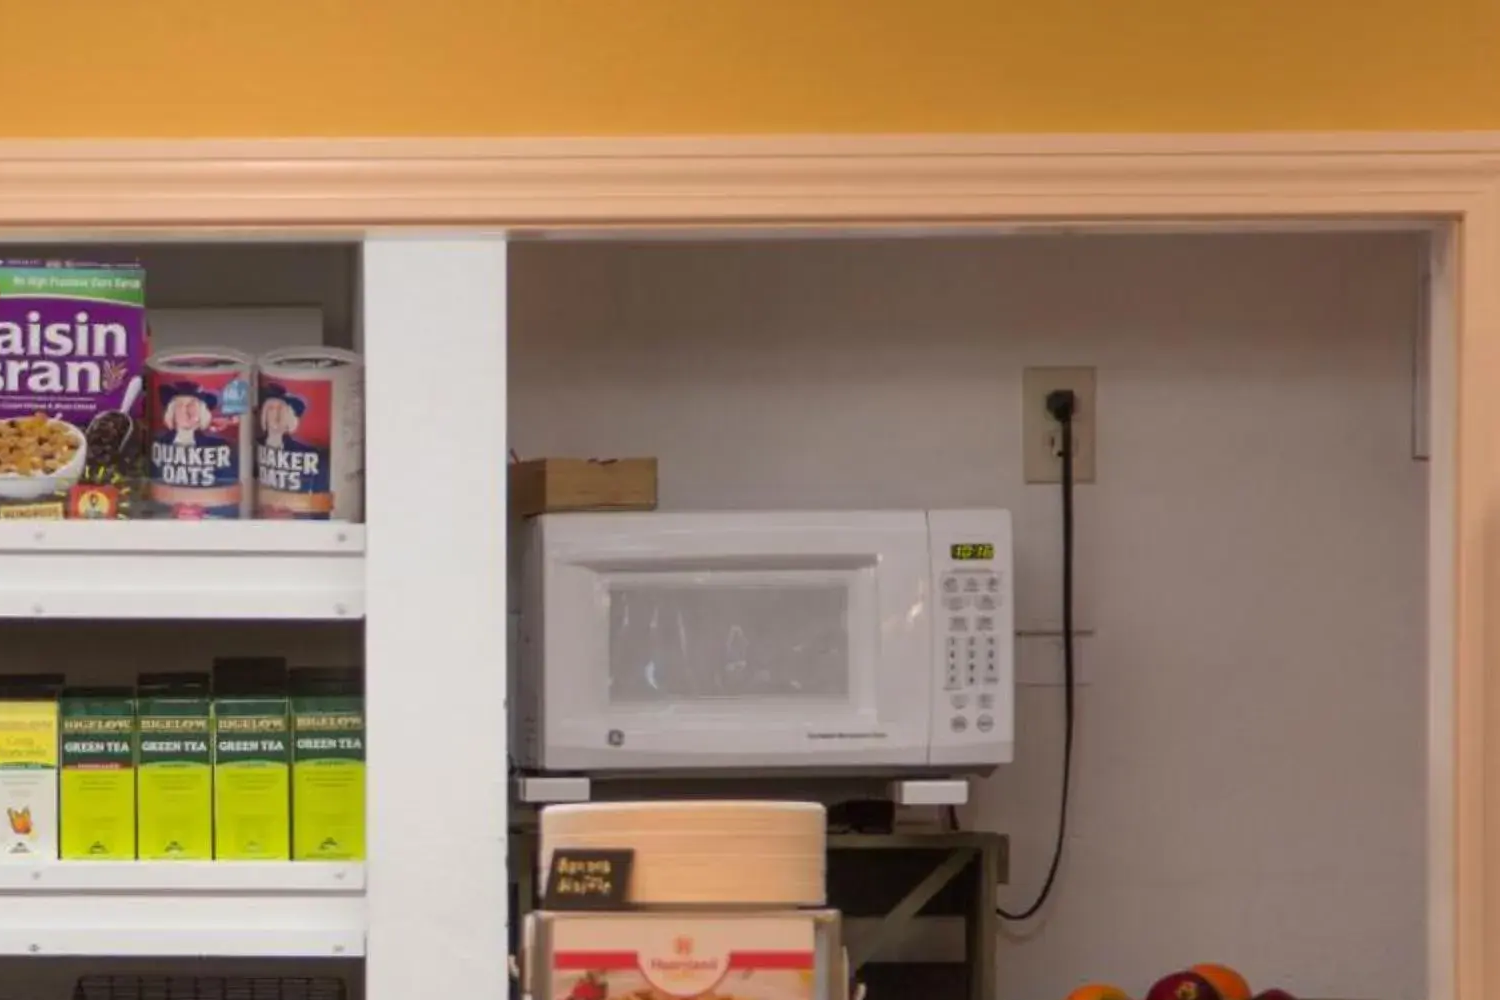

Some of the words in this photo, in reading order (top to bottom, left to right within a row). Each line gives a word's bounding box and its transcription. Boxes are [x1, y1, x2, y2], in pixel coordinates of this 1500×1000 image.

[152, 442, 231, 468] QUAKER
[257, 444, 319, 474] UAKER
[163, 466, 216, 487] OATS
[259, 467, 301, 490] OATS
[64, 719, 131, 729] BIGELOW
[141, 719, 206, 729] BIGELOW
[218, 719, 284, 729] BIGELOW
[296, 717, 362, 727] BIGELOW
[64, 741, 105, 752] GREEN
[106, 742, 130, 752] TEA
[141, 741, 181, 751] GREEN
[182, 741, 207, 751] TEA
[218, 741, 259, 751] GREEN
[260, 741, 284, 751] TEA
[297, 738, 337, 749] GREEN
[338, 738, 362, 749] TEA
